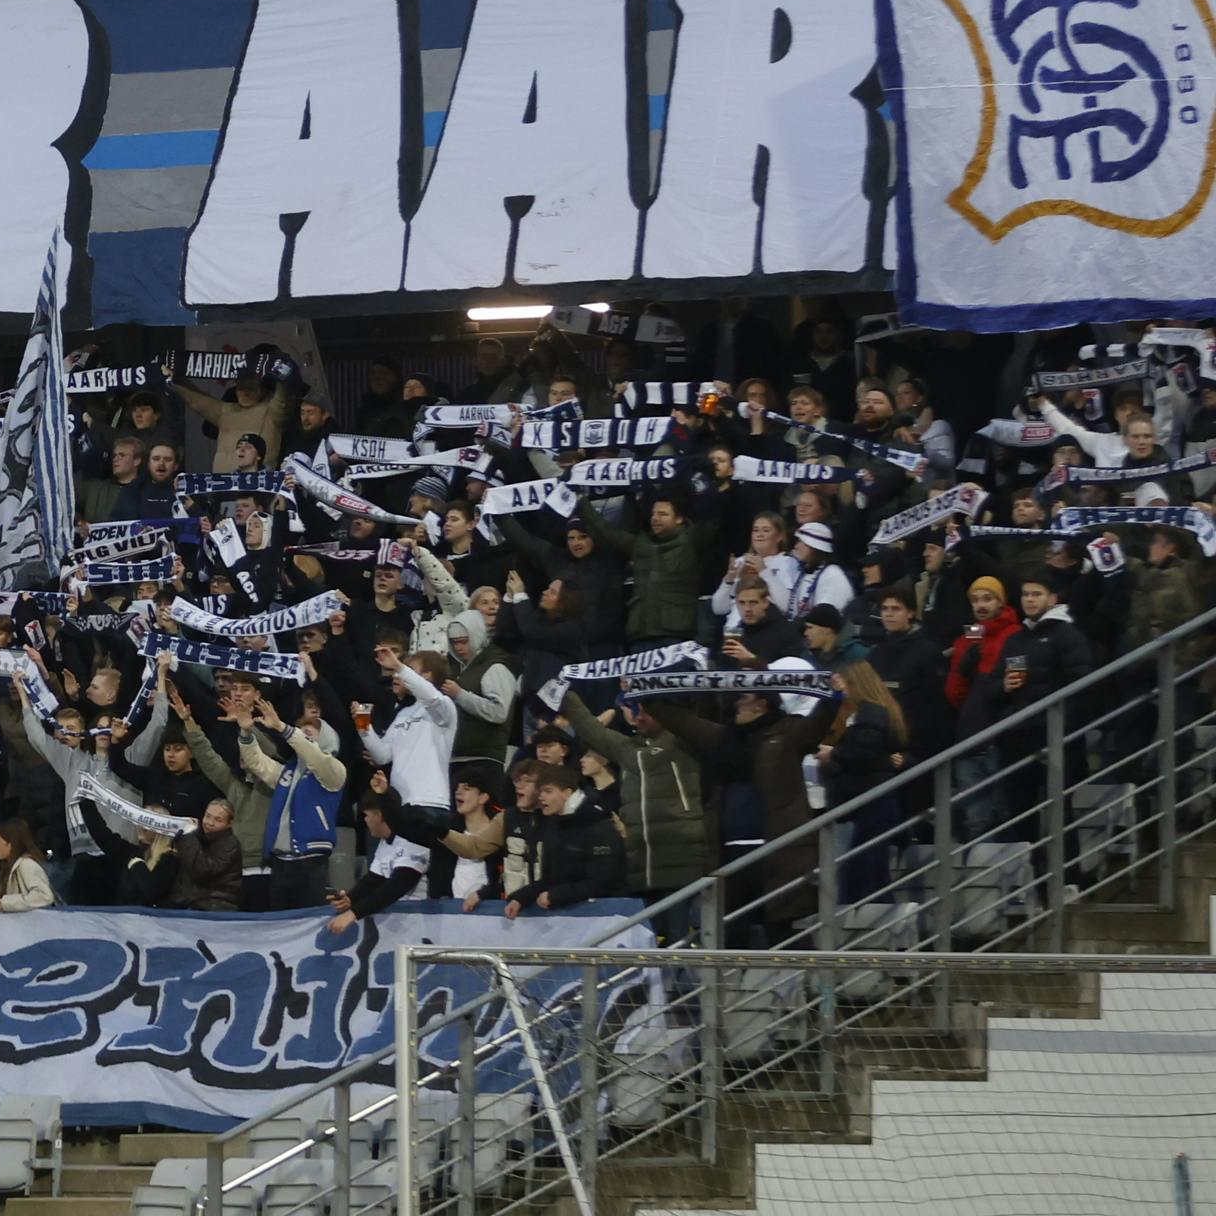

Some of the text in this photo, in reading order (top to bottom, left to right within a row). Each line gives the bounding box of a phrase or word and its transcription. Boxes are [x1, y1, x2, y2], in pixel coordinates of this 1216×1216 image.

[598, 315, 630, 332] AGF
[67, 367, 146, 390] AARHUS
[459, 406, 496, 422] AARHUS
[351, 437, 387, 458] KSDH
[584, 457, 676, 481] AARHUS
[757, 460, 834, 481] AARHUS
[220, 609, 297, 636] AARHUS
[585, 646, 667, 678] AARHUS
[752, 672, 831, 691] AARHUS
